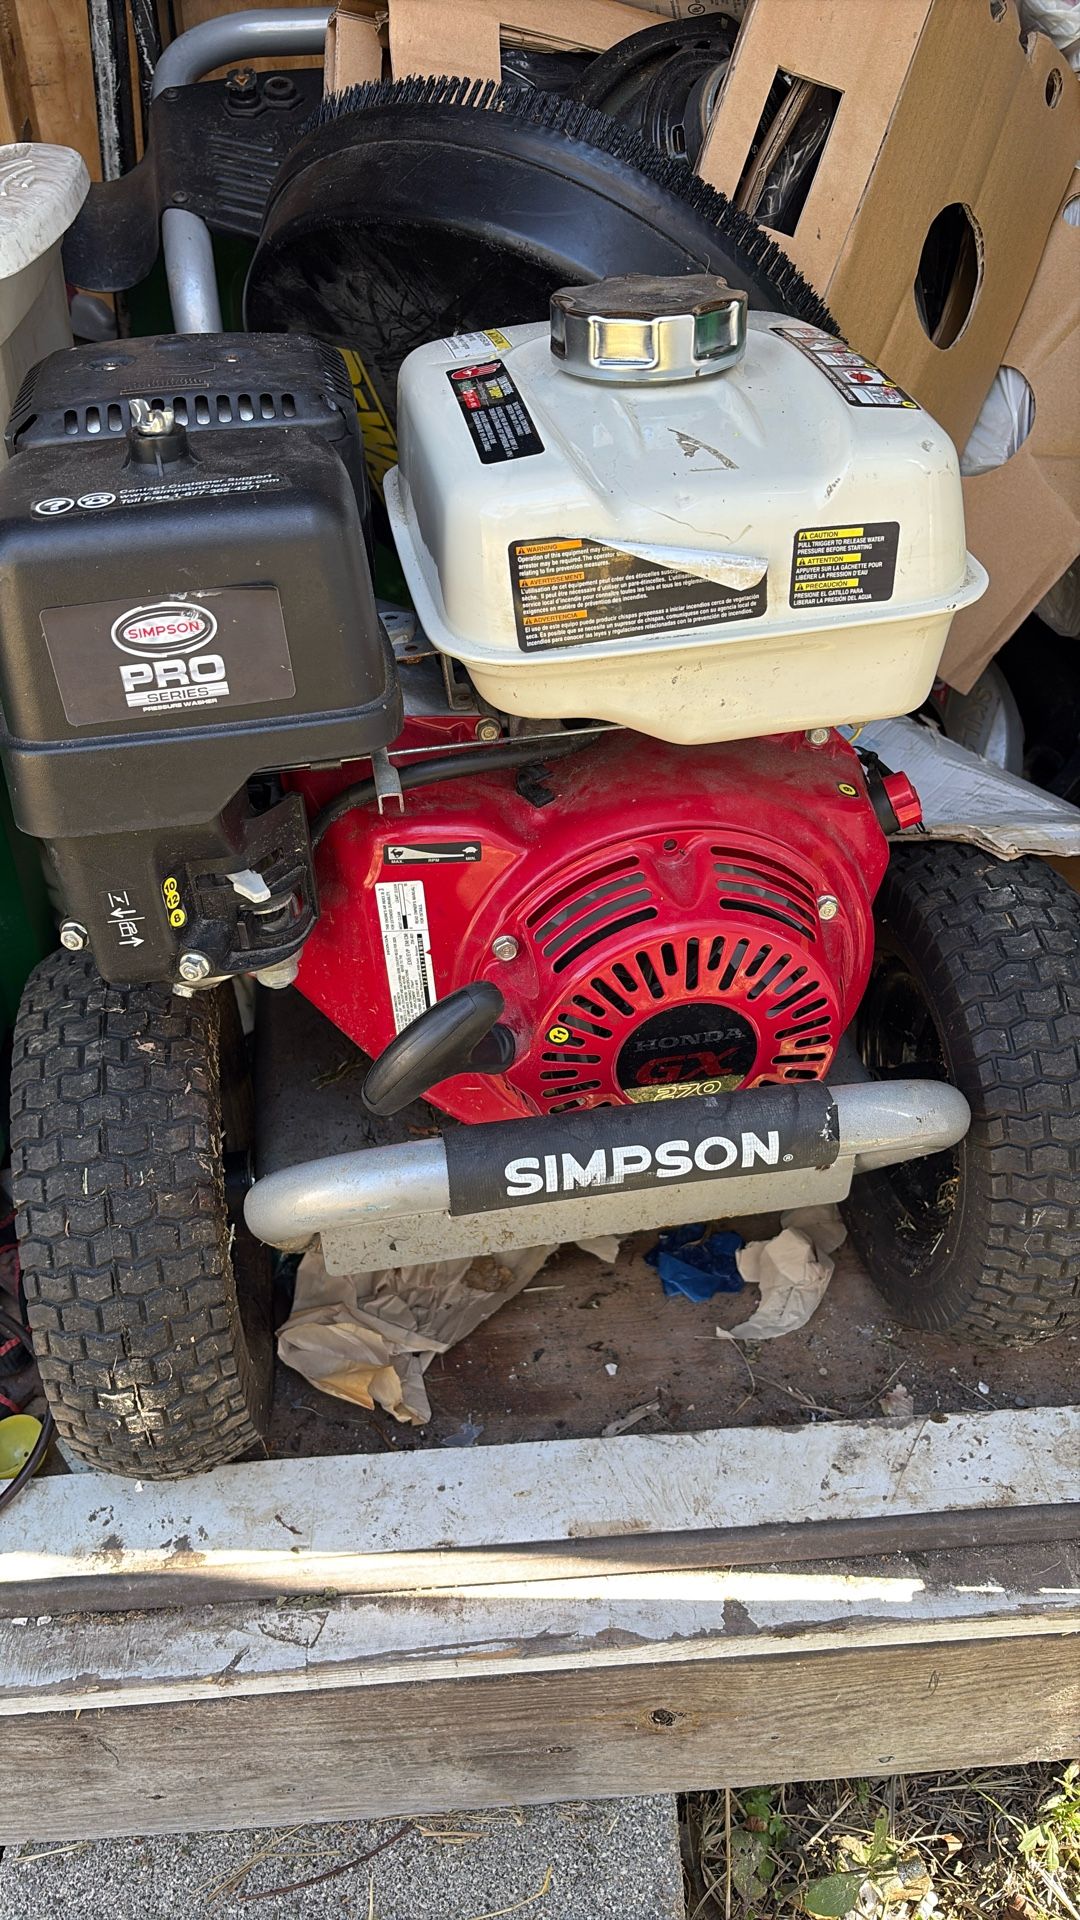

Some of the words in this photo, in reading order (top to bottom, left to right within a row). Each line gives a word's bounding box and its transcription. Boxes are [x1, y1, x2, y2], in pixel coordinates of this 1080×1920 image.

[120, 486, 165, 494] Contact
[168, 480, 224, 488] Customer
[120, 478, 280, 498] www.SimpsonCleaning.com
[810, 531, 838, 539] CAUTION
[517, 555, 542, 563] Operation
[562, 549, 588, 558] equipment
[559, 556, 582, 565] required.
[593, 552, 614, 560] operator
[808, 556, 844, 564] ATTENTION
[556, 564, 582, 573] prevention
[530, 574, 582, 585] AVERTISSEMENT
[796, 573, 817, 581] LIBÉRER
[806, 581, 848, 589] PRECAUCIÓN
[824, 595, 846, 603] PRESIÓN
[560, 620, 578, 628] equipo
[579, 617, 594, 626] puede
[596, 614, 616, 623] producir
[638, 608, 664, 617] propensas
[686, 601, 710, 609] incendios
[732, 593, 759, 603] vegetación
[533, 613, 578, 623] ADVERTENCIA
[128, 621, 200, 639] SIMPSON
[526, 638, 550, 647] incendios
[612, 625, 643, 634] regulaciones
[644, 620, 676, 629] relacionadas
[692, 613, 720, 623] prevención
[728, 608, 753, 617] incendios.
[120, 654, 226, 692] PRO
[147, 687, 209, 702] SERIES
[143, 702, 182, 712] PRESSURE
[184, 698, 218, 707] WASHER
[634, 1028, 746, 1052] HONDA
[636, 1047, 741, 1084] GX
[654, 1080, 722, 1101] 270
[504, 1131, 780, 1196] SIMPSON
